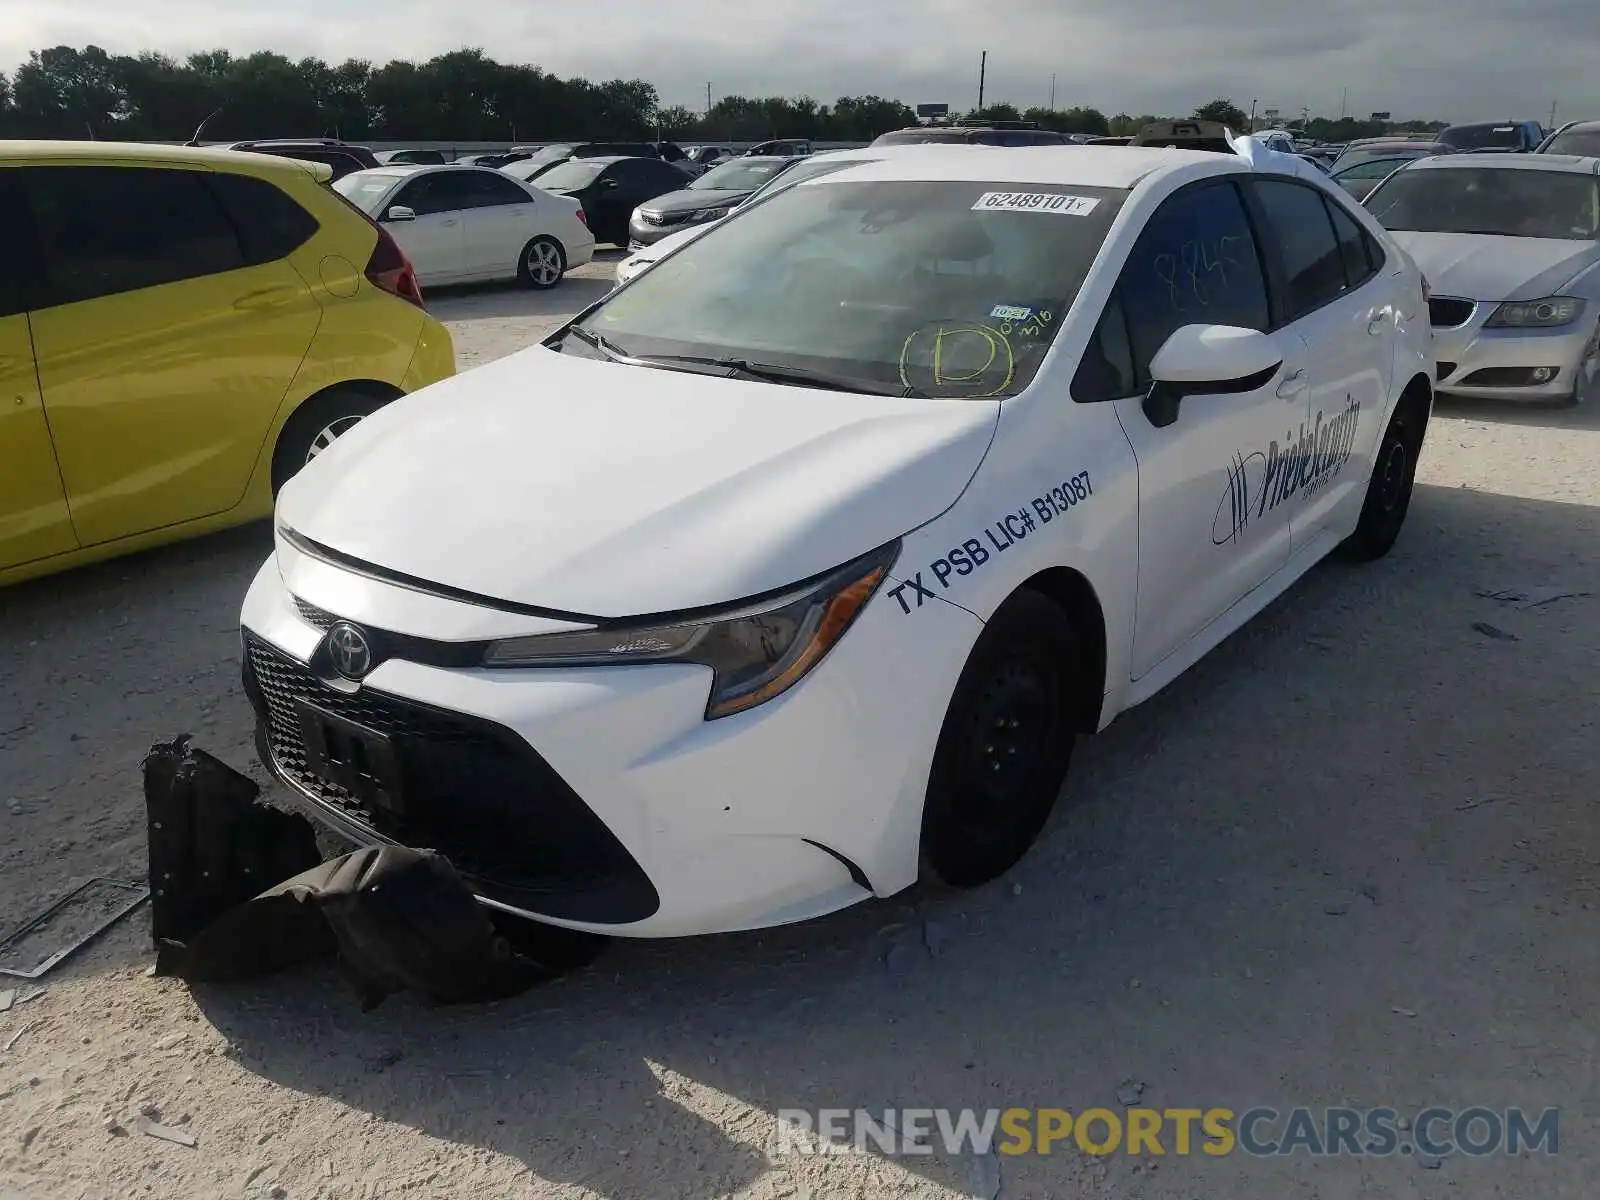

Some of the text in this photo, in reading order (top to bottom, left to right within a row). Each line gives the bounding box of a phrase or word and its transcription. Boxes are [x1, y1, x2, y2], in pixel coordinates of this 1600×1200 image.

[887, 470, 1093, 615] TX PSB LIC# B13087
